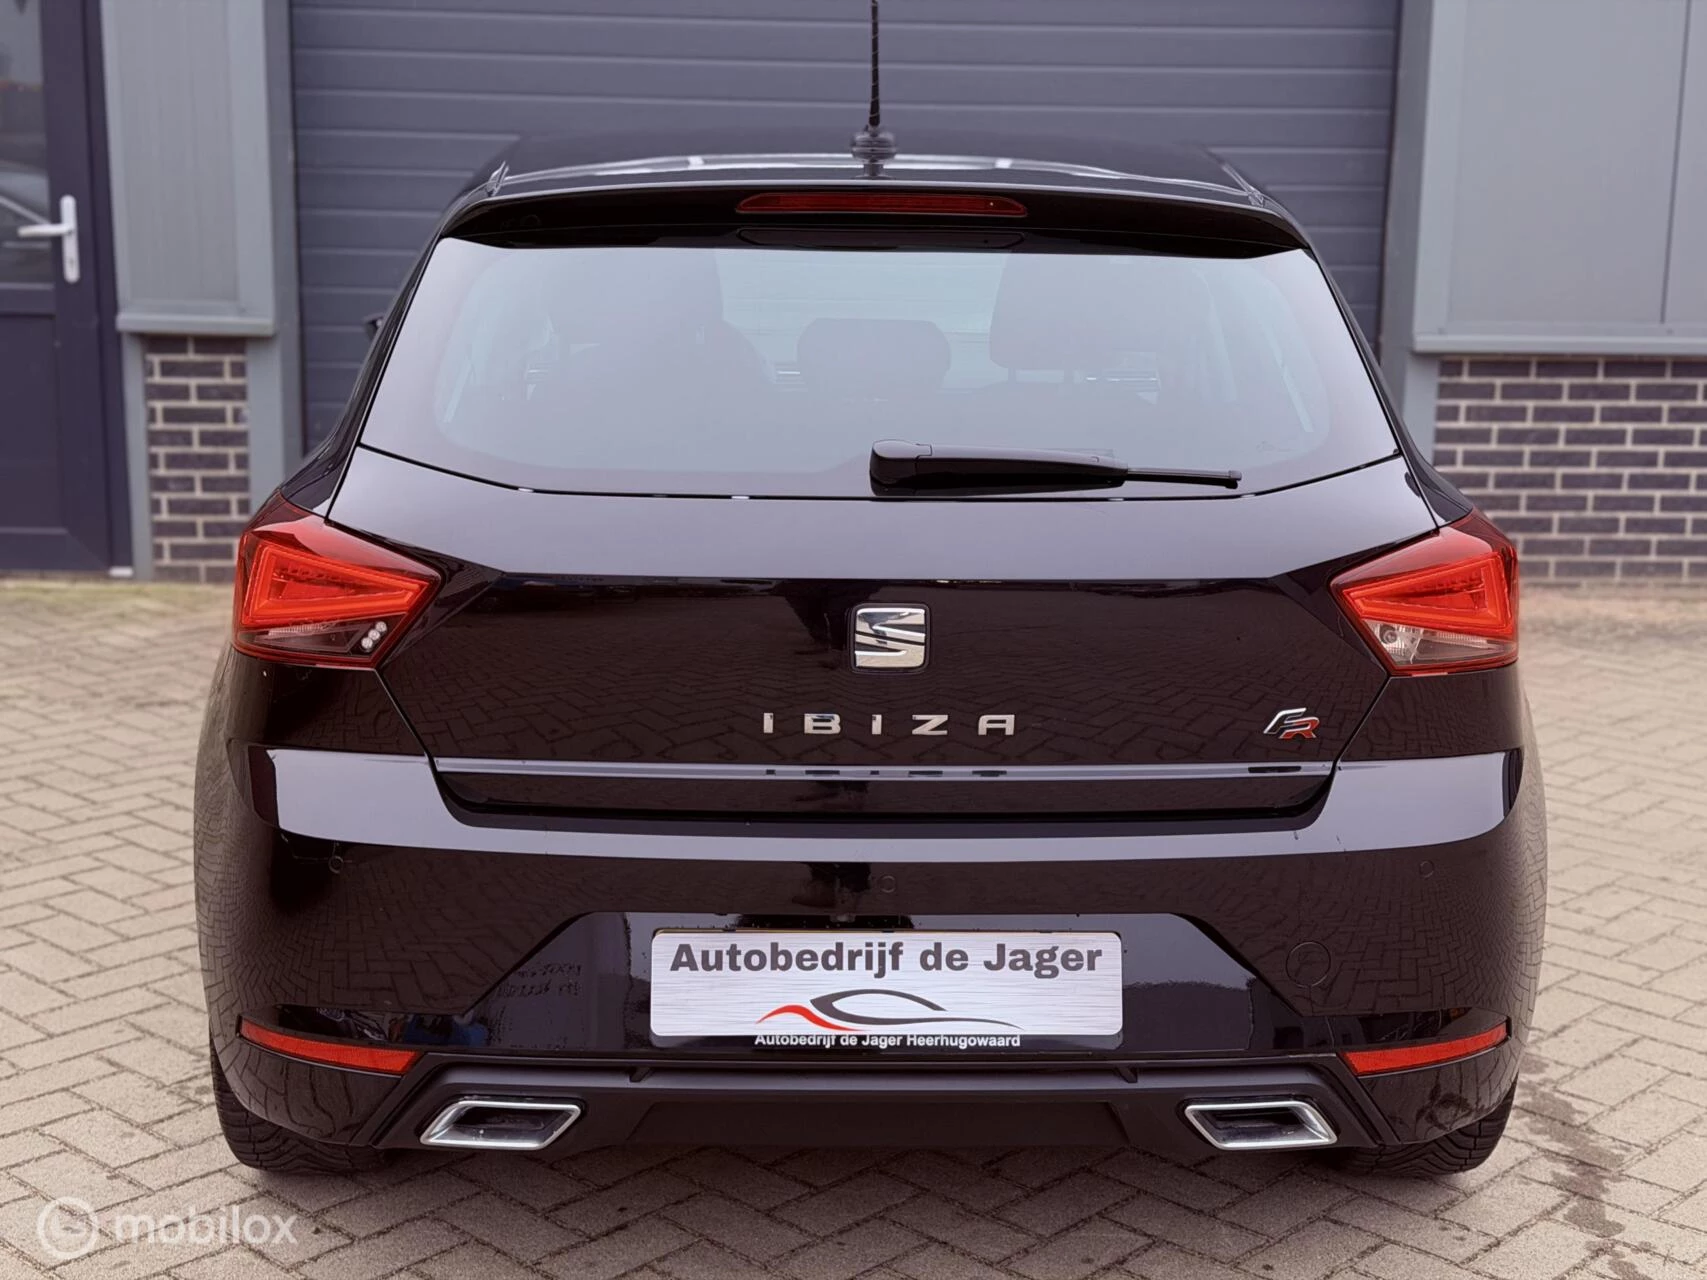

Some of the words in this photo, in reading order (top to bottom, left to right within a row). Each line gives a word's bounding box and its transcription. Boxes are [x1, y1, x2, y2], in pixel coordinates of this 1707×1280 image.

[762, 712, 1016, 736] IBIZA
[1263, 707, 1321, 740] FR
[669, 941, 905, 979] Autobedrijf
[919, 942, 970, 972] de
[983, 942, 1104, 979] Jager
[754, 1034, 837, 1049] Autobedrijf
[840, 1034, 858, 1046] de
[861, 1034, 904, 1049] Jager
[906, 1034, 1021, 1050] Heerhugowaard
